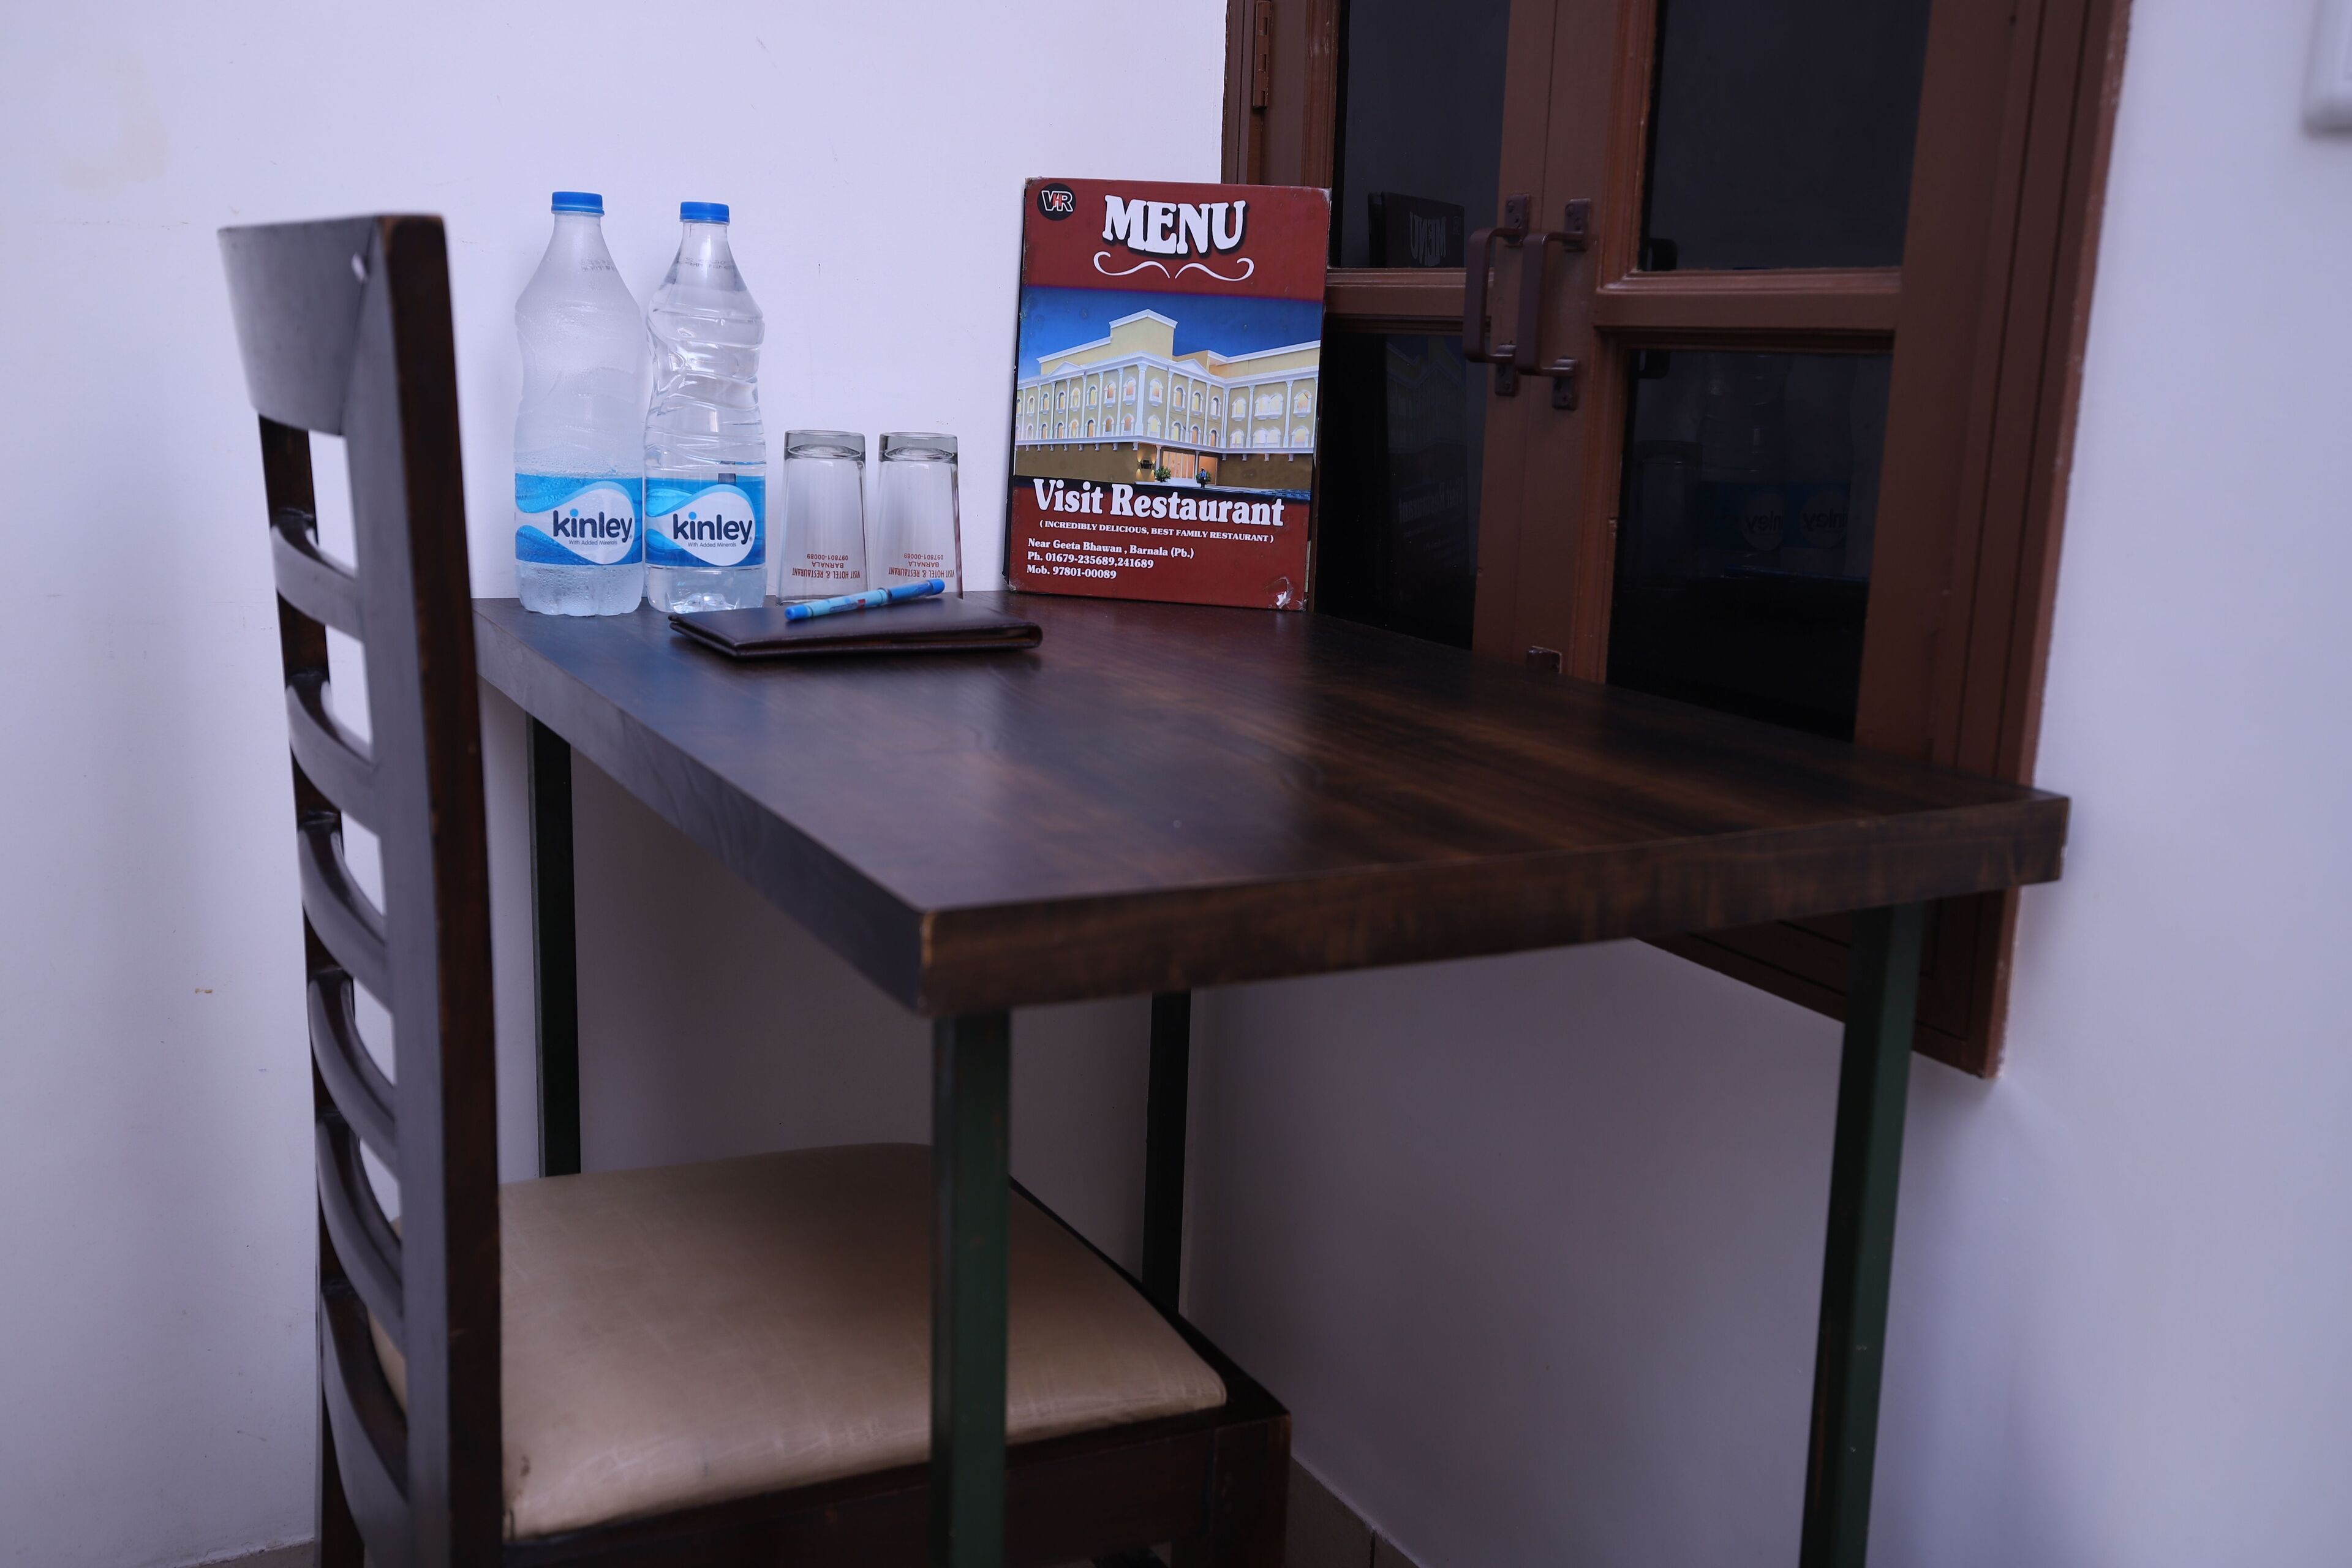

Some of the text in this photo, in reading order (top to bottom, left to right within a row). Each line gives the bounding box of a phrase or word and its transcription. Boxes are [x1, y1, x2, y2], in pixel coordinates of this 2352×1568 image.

[1102, 195, 1246, 255] MENU
[1033, 478, 1284, 526] Visit Restaurant
[553, 508, 633, 543] kinley
[673, 511, 753, 545] kinley
[1045, 521, 1098, 530] INCREDIBLY
[1099, 524, 1149, 535] DELICIOUS,
[1151, 527, 1174, 536] BEST
[1176, 529, 1208, 538] FAMILY
[1210, 532, 1269, 542] RESTAURANT
[1028, 538, 1051, 548] Near
[1053, 540, 1080, 551] Geeta
[1083, 542, 1122, 552] Bhawan
[1129, 545, 1169, 556] Barnala
[1027, 551, 1154, 568] Ph. 01679-235689,241689
[792, 567, 824, 578] RESTAURANT
[851, 570, 861, 579] VISIT
[888, 567, 920, 578] RESTAURANT
[929, 570, 944, 578] HOTEL
[1027, 564, 1117, 579] Mob. 97801-00089
